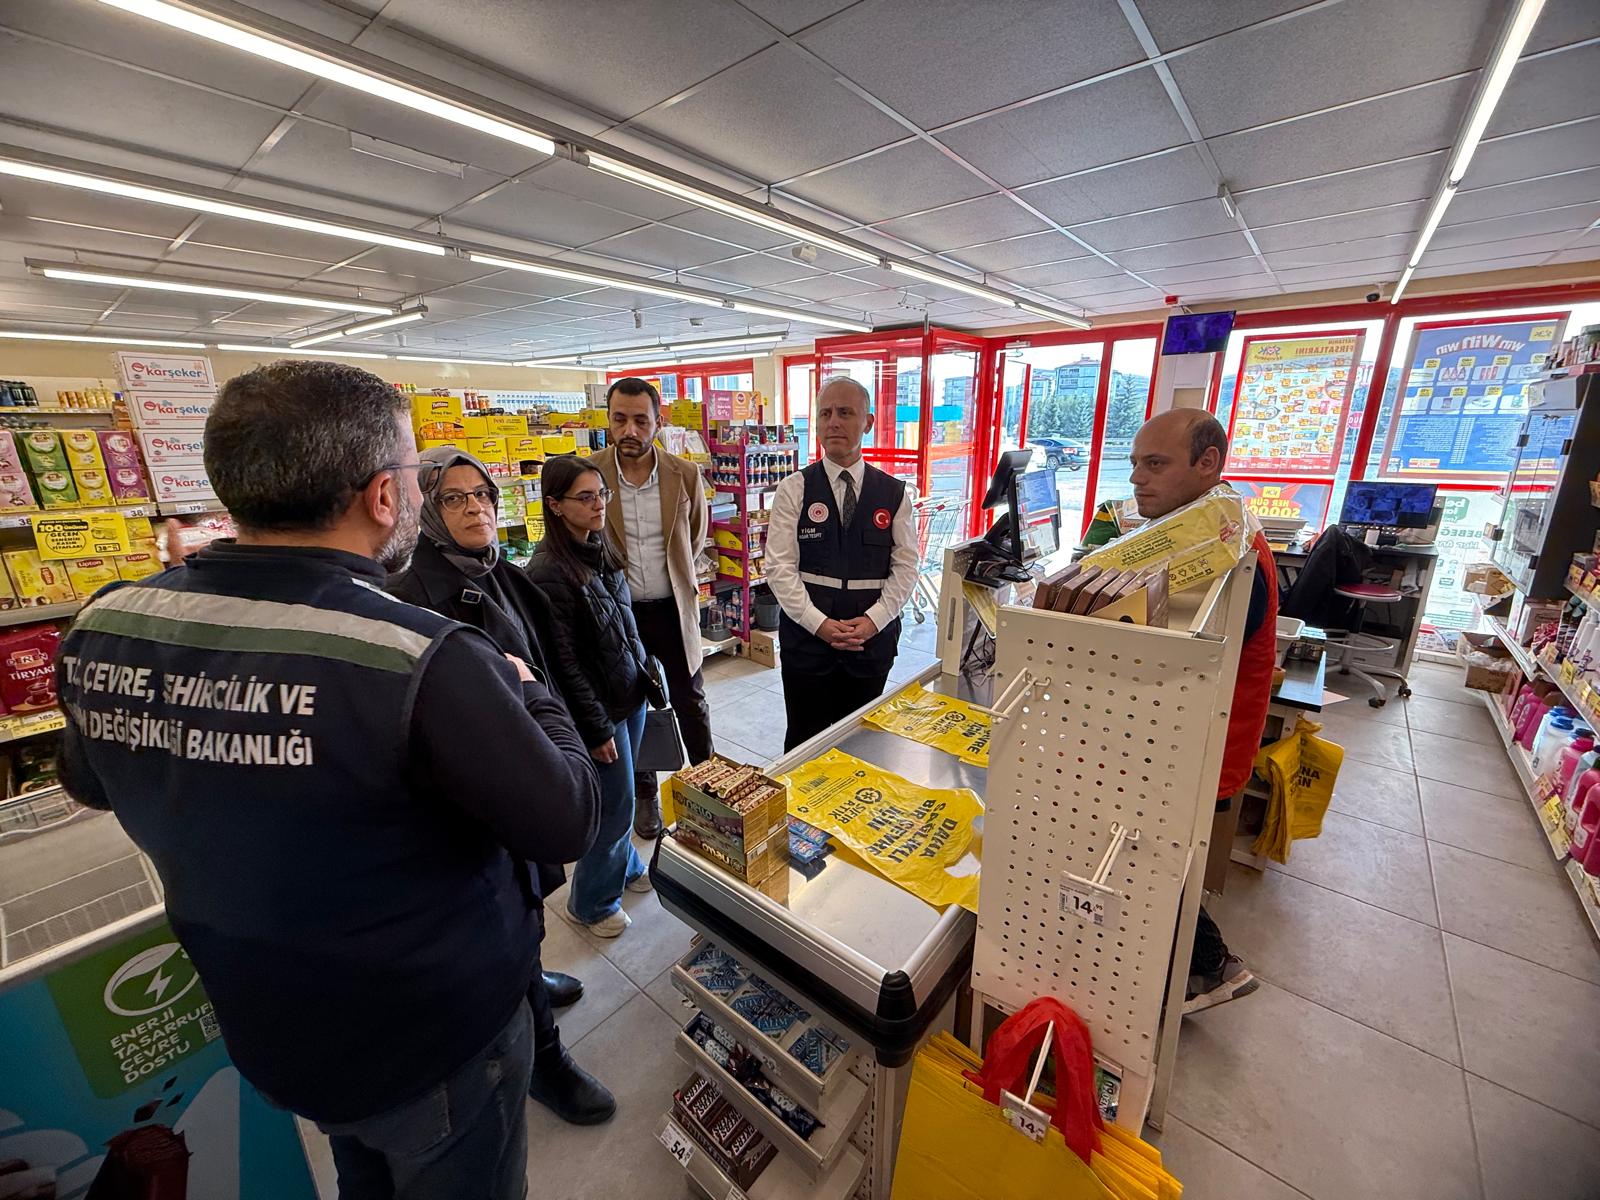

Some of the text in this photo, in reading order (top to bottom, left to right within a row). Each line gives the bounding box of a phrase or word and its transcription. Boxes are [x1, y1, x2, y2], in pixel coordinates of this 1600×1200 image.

[145, 367, 203, 378] karşeker
[157, 403, 207, 415] karşeke
[38, 524, 63, 532] 100
[78, 560, 102, 568] Lipton
[8, 664, 56, 680] TİRYAKİ
[83, 661, 155, 703] ÇEVRE,
[280, 684, 317, 716] VE
[186, 729, 314, 766] BAKANLIĞI
[828, 800, 856, 820] ATIK
[1073, 896, 1093, 914] 14
[120, 1032, 180, 1074] ÇEVRE
[124, 1040, 191, 1084] DOSTU
[1019, 1117, 1035, 1134] 14
[670, 1140, 686, 1160] 54
